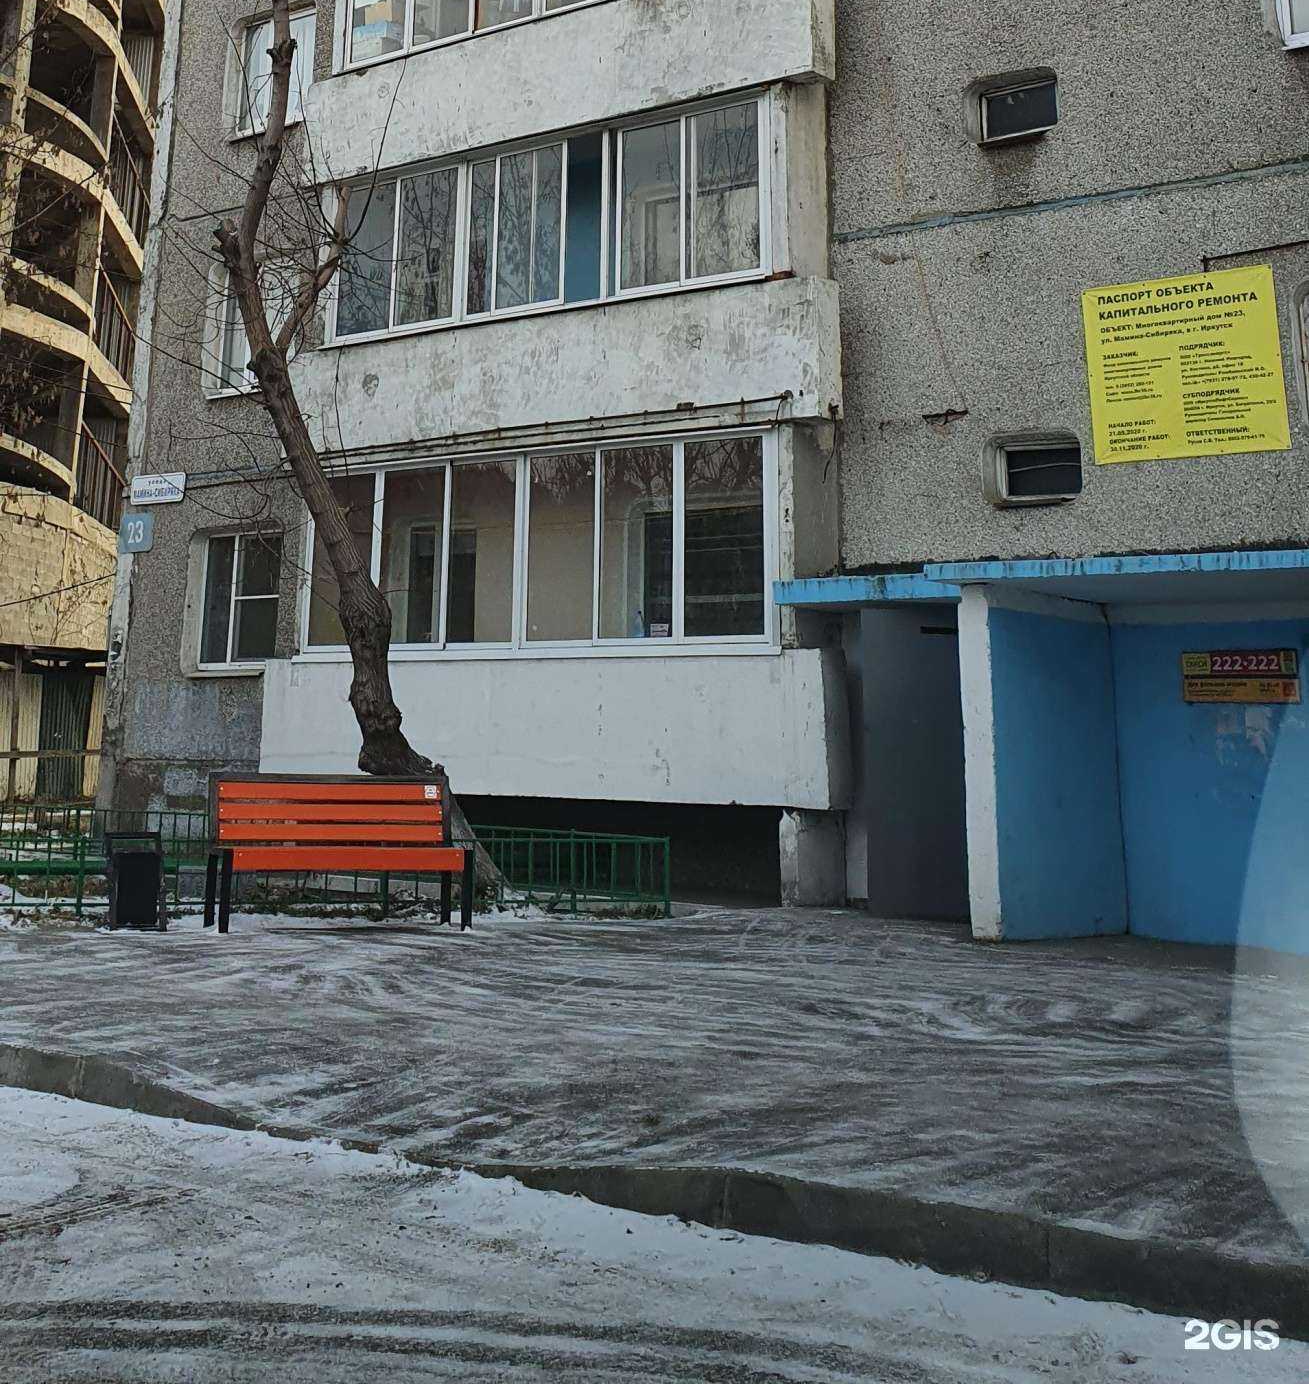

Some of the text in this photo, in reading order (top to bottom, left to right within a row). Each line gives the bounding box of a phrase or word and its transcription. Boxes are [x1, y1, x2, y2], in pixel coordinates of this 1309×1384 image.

[1098, 282, 1214, 305] ПАСПОРТ ОБЪЕКТА
[1099, 292, 1258, 320] КАПИТАЛЬНОГО РЕМОНТА
[1101, 324, 1133, 334] ОБЪЕКТ:
[1207, 313, 1221, 321] дом
[128, 521, 144, 543] 23
